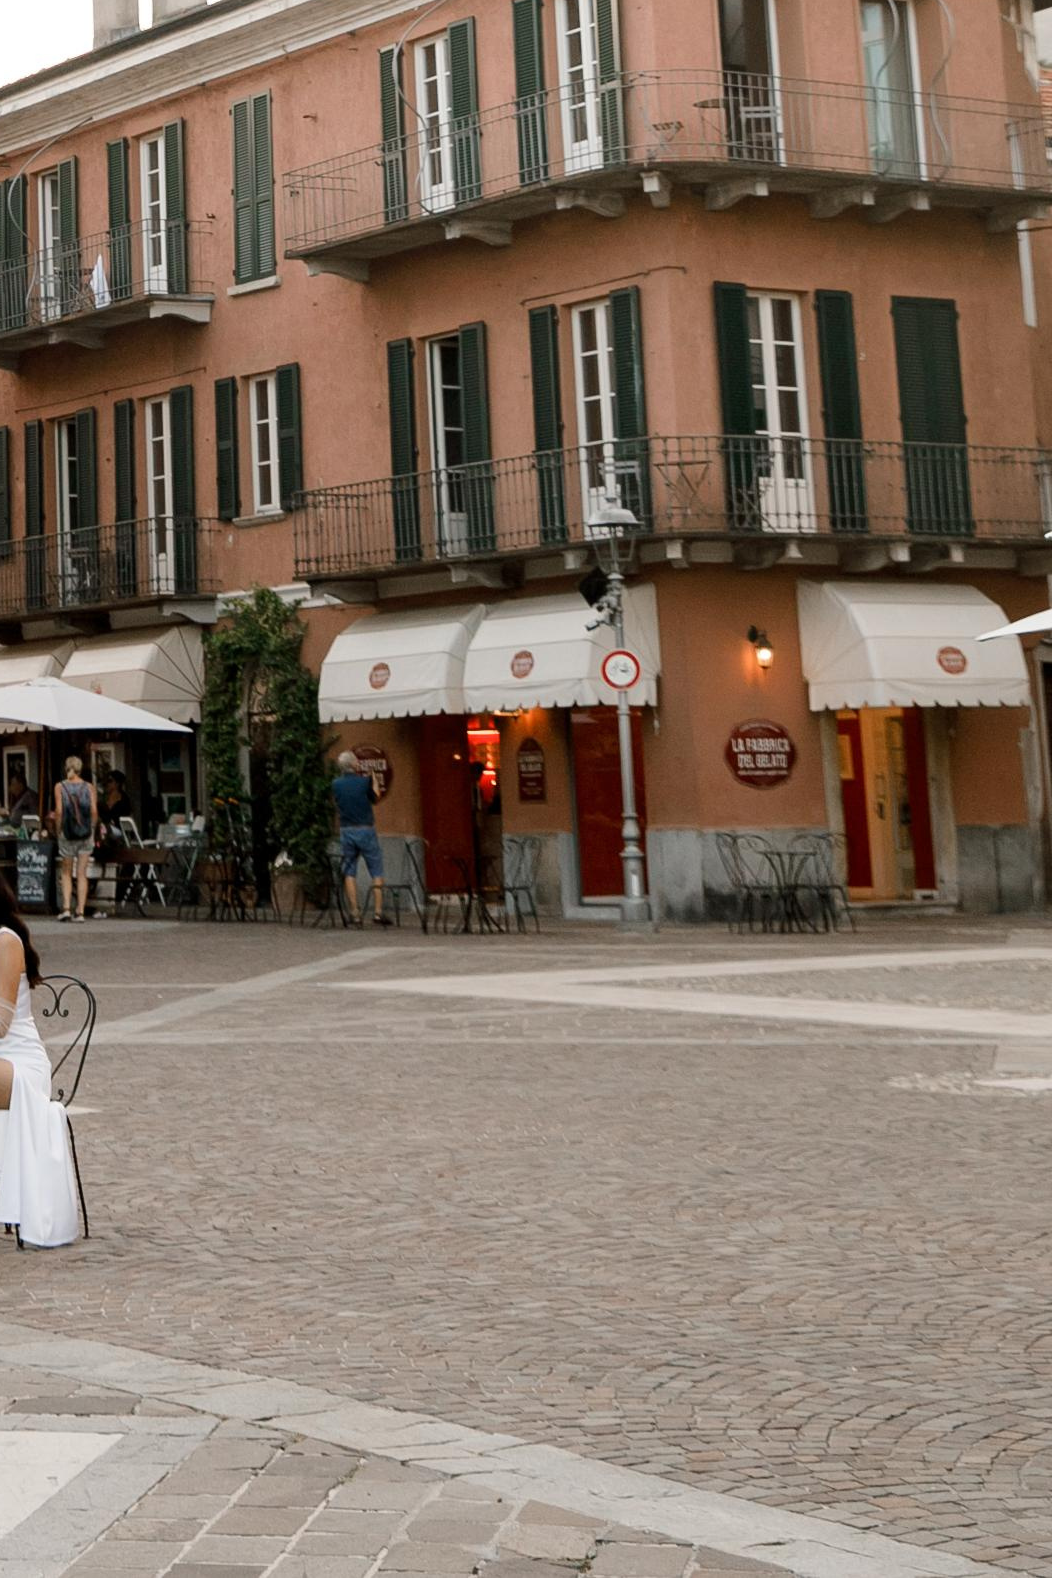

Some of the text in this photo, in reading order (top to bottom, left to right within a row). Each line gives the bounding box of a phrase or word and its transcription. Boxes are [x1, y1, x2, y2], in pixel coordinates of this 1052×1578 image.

[731, 738, 790, 752] LA FABBRICA
[738, 754, 788, 768] DEL GELATO
